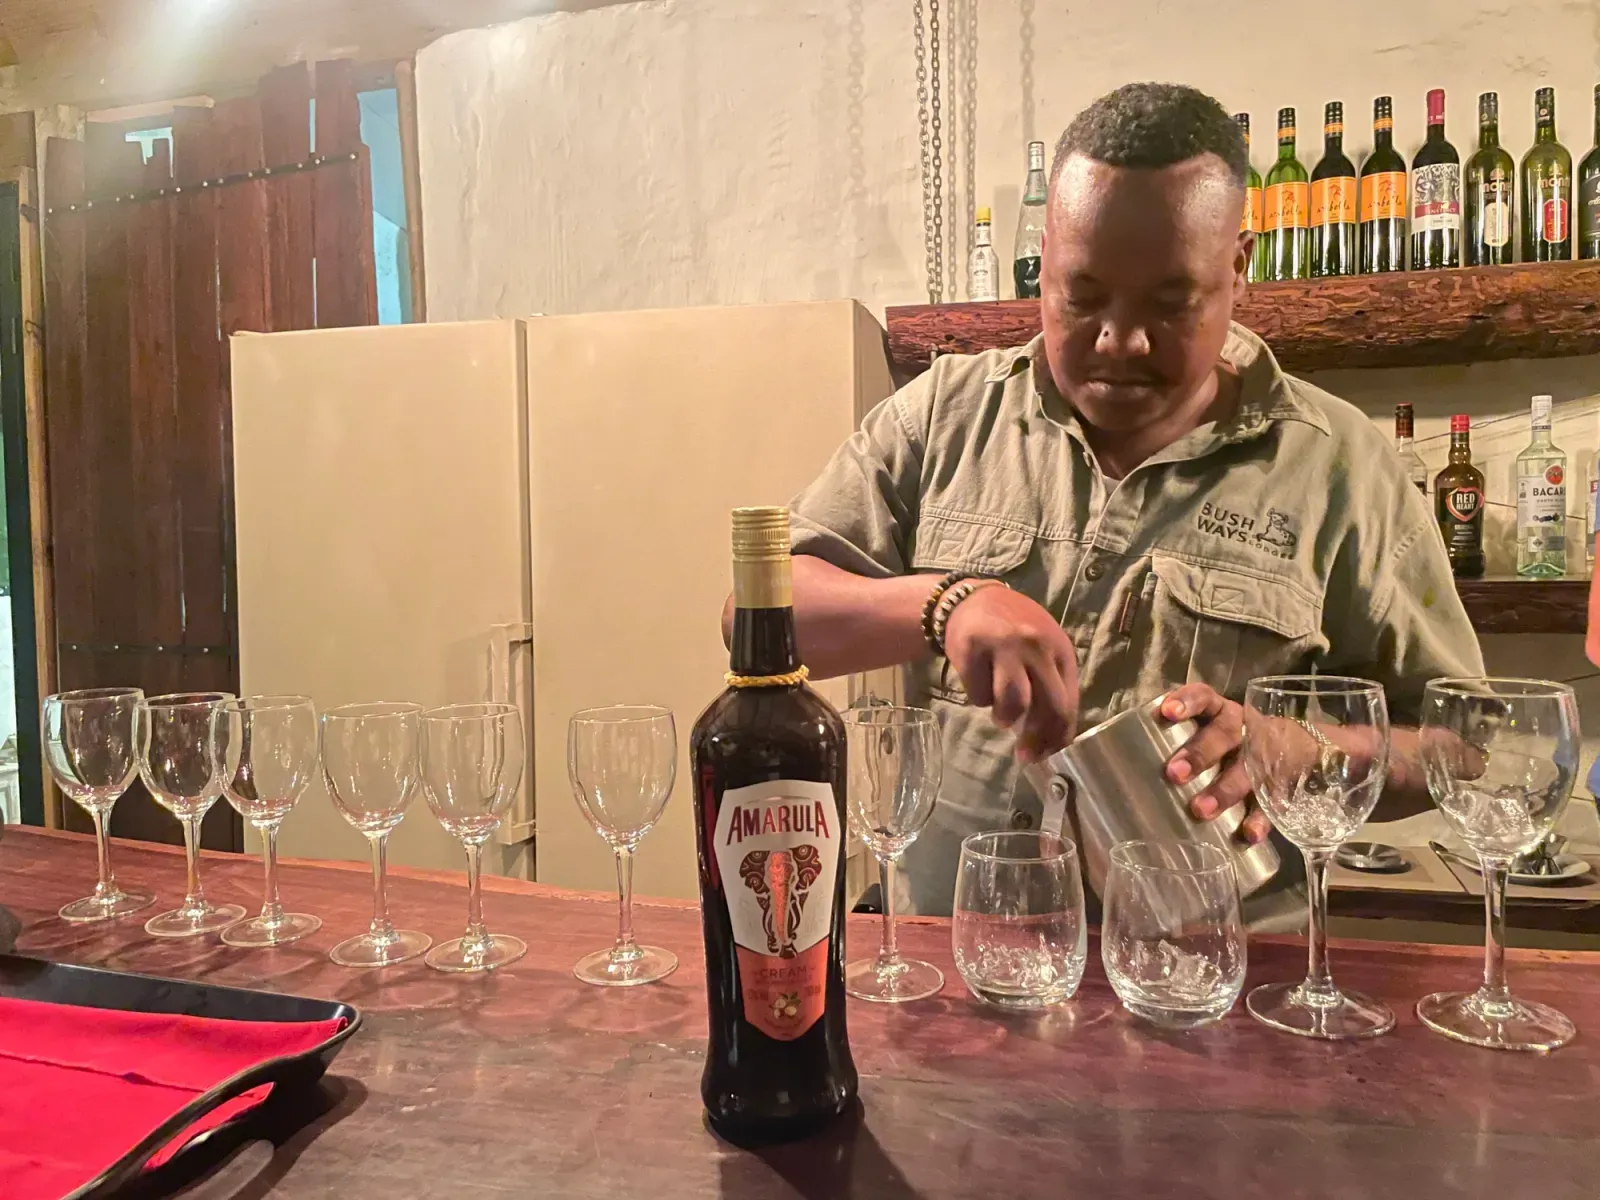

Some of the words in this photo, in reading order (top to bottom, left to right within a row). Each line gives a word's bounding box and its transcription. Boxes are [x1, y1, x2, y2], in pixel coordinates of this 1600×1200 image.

[1456, 493, 1475, 503] RED
[1532, 486, 1566, 496] BACAR
[1456, 502, 1475, 511] HEART
[1201, 502, 1254, 531] BUSH
[1197, 515, 1248, 543] WAYS
[726, 800, 830, 846] AMARULA
